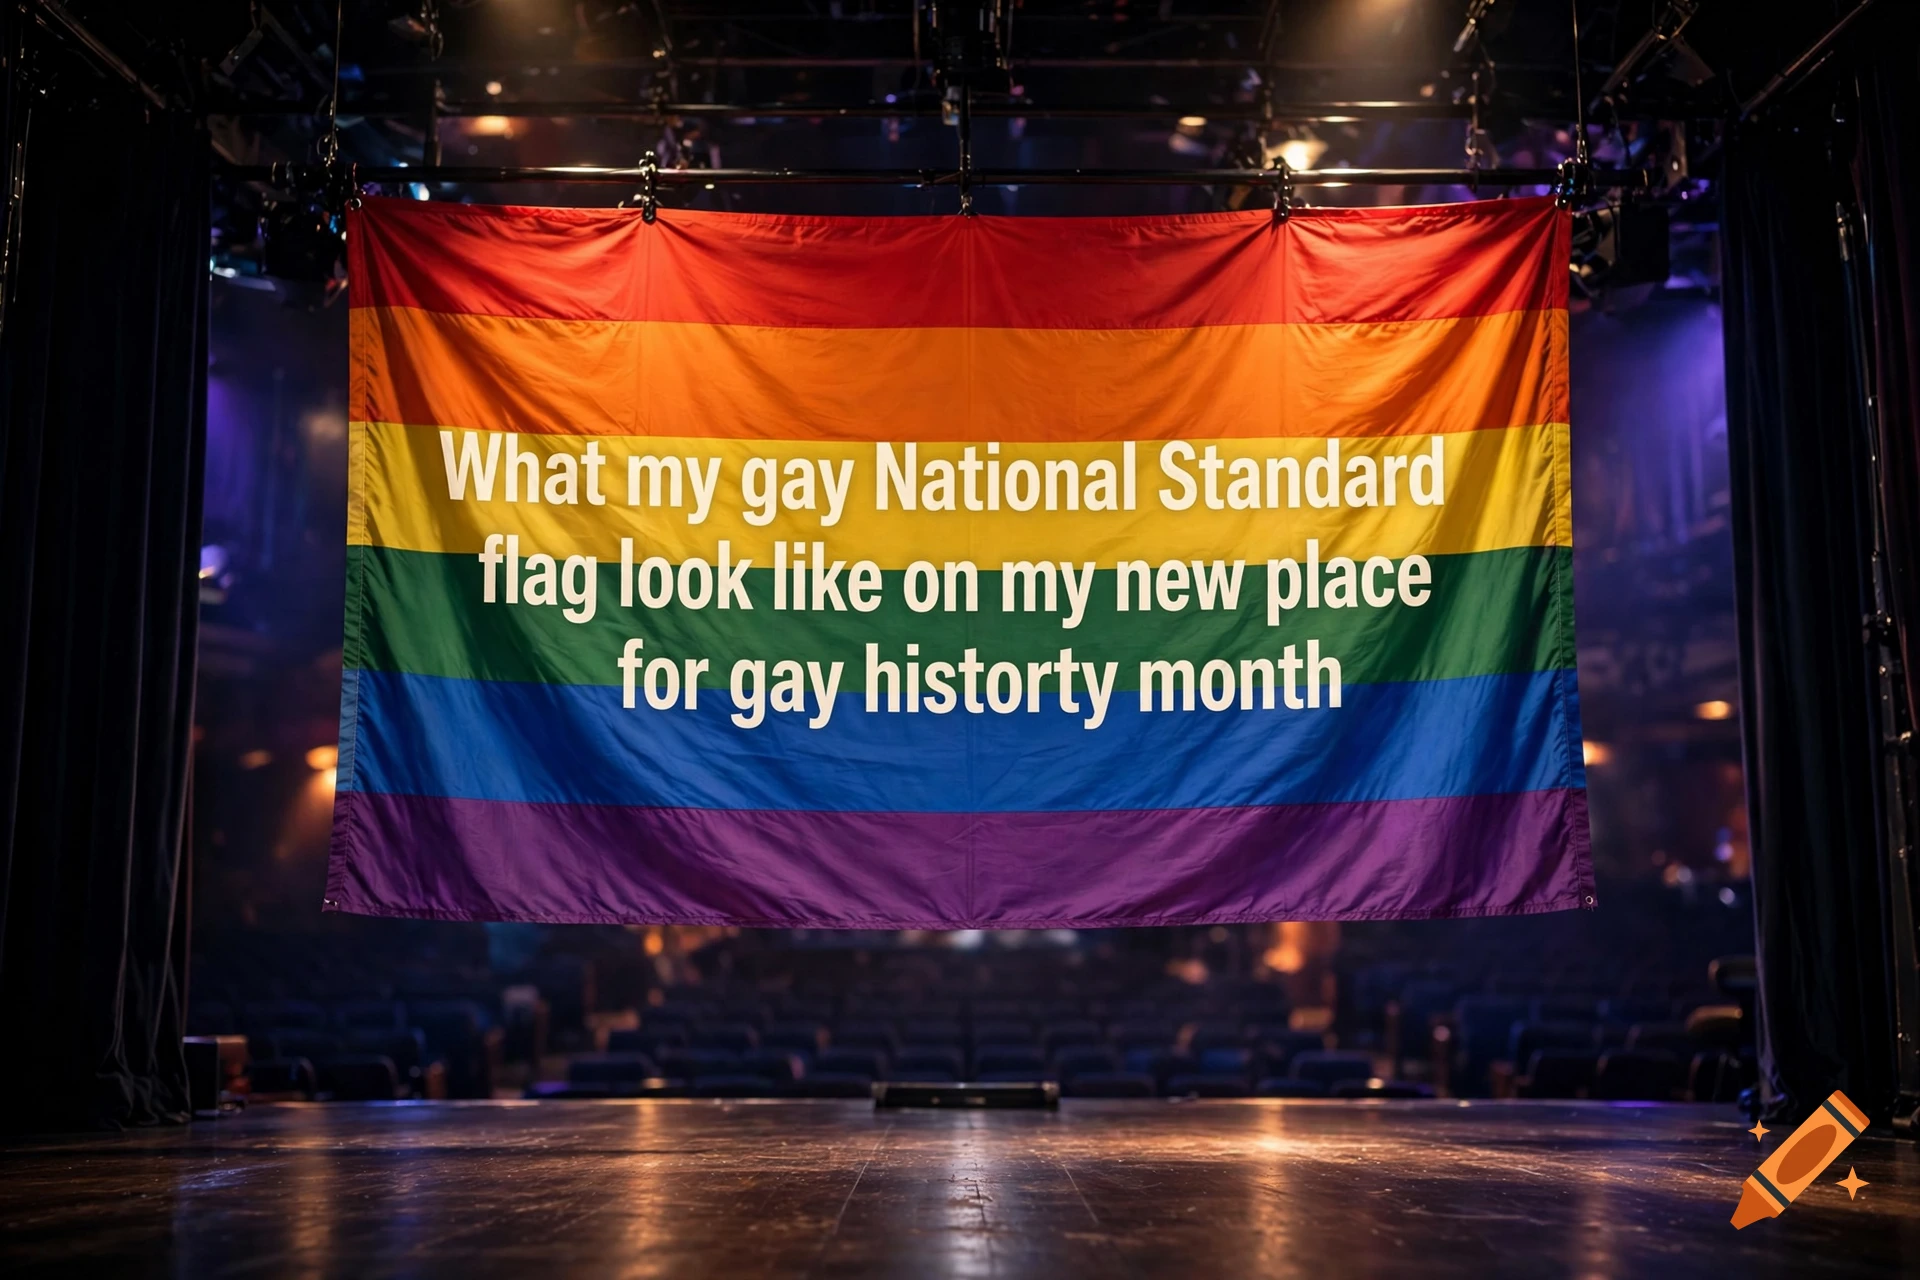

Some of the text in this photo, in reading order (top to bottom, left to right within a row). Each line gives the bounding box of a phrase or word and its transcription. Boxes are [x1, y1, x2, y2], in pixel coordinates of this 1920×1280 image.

[439, 431, 1446, 527] What my gay National Standard
[478, 533, 1432, 629] flag look like on my new place
[617, 638, 1342, 730] for gay historty month
